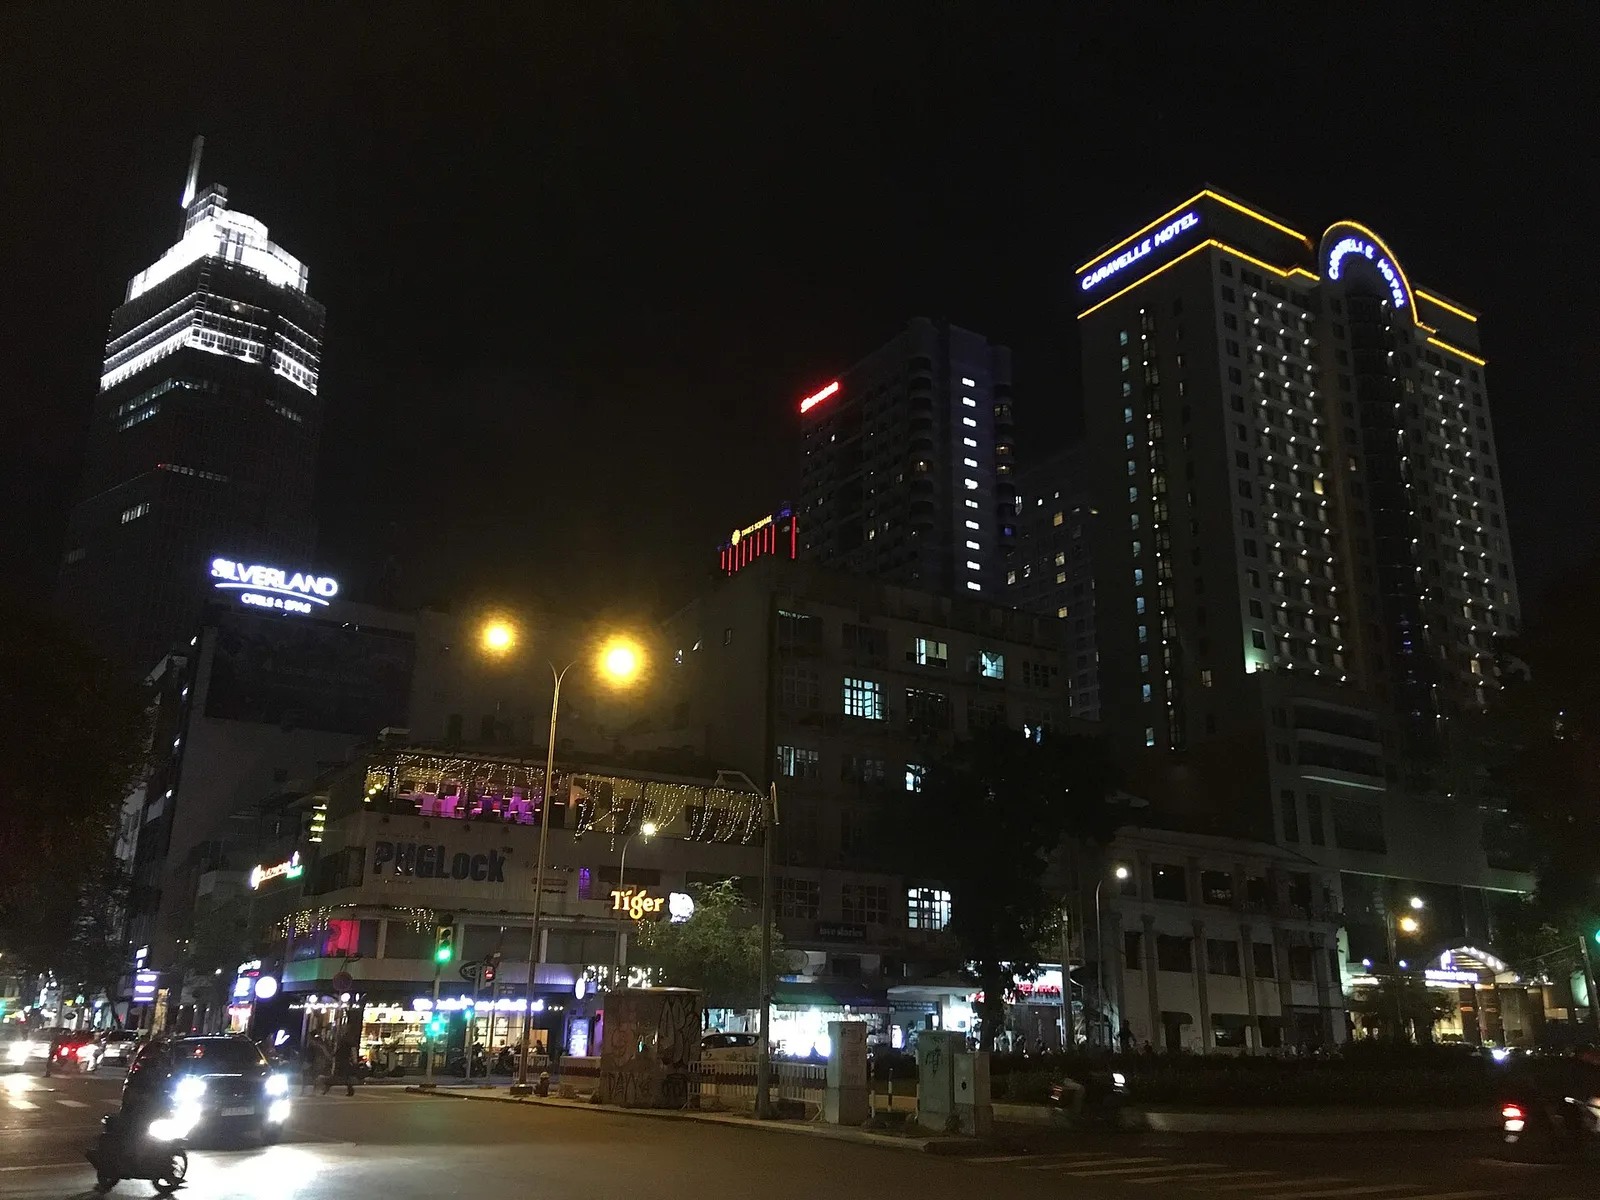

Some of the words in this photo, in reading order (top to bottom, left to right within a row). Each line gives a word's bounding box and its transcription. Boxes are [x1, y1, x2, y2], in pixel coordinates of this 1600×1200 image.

[1082, 239, 1151, 290] CARAVELLE
[1154, 212, 1198, 247] HOTEL
[210, 558, 338, 597] SILVERLAND
[610, 889, 665, 920] Tiger
